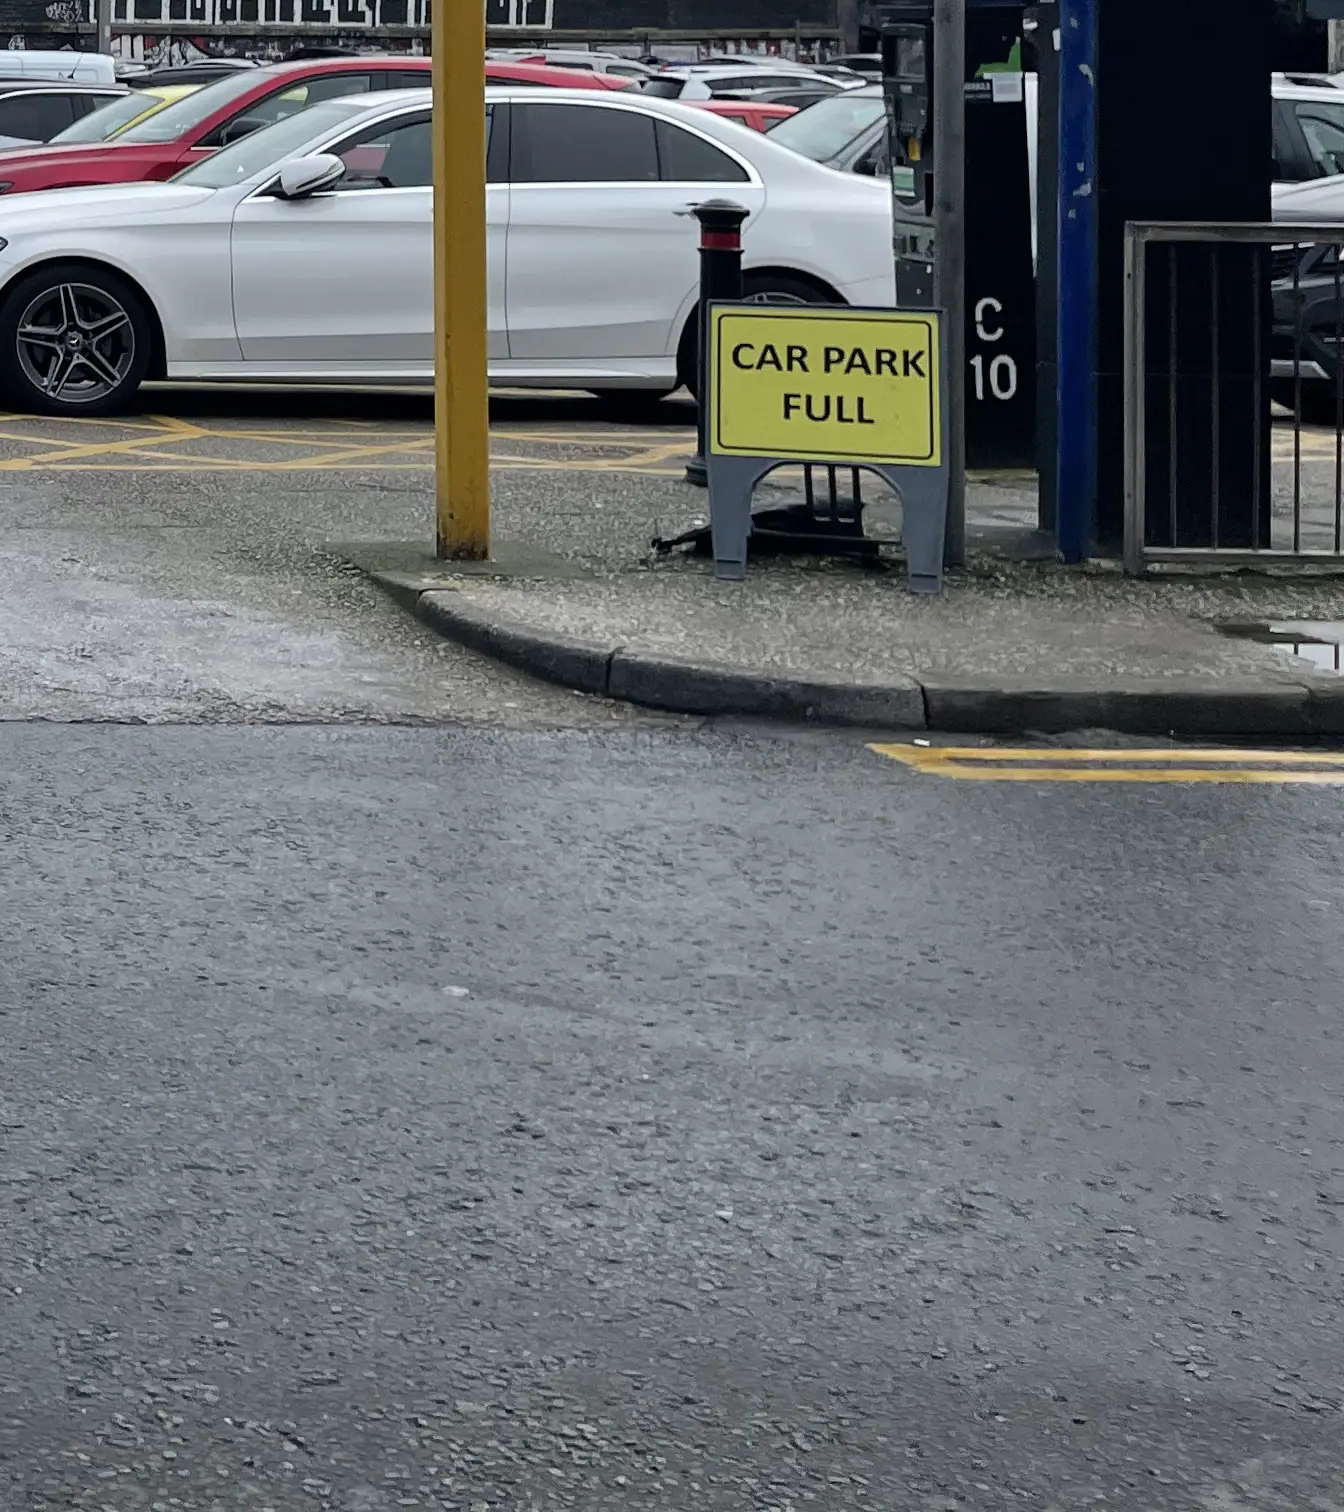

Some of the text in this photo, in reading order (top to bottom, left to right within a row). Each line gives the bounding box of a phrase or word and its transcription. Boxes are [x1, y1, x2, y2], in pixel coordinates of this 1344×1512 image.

[974, 297, 1004, 341] C
[732, 343, 926, 378] CAR PARK
[969, 353, 1018, 401] 10
[783, 393, 875, 424] FULL
